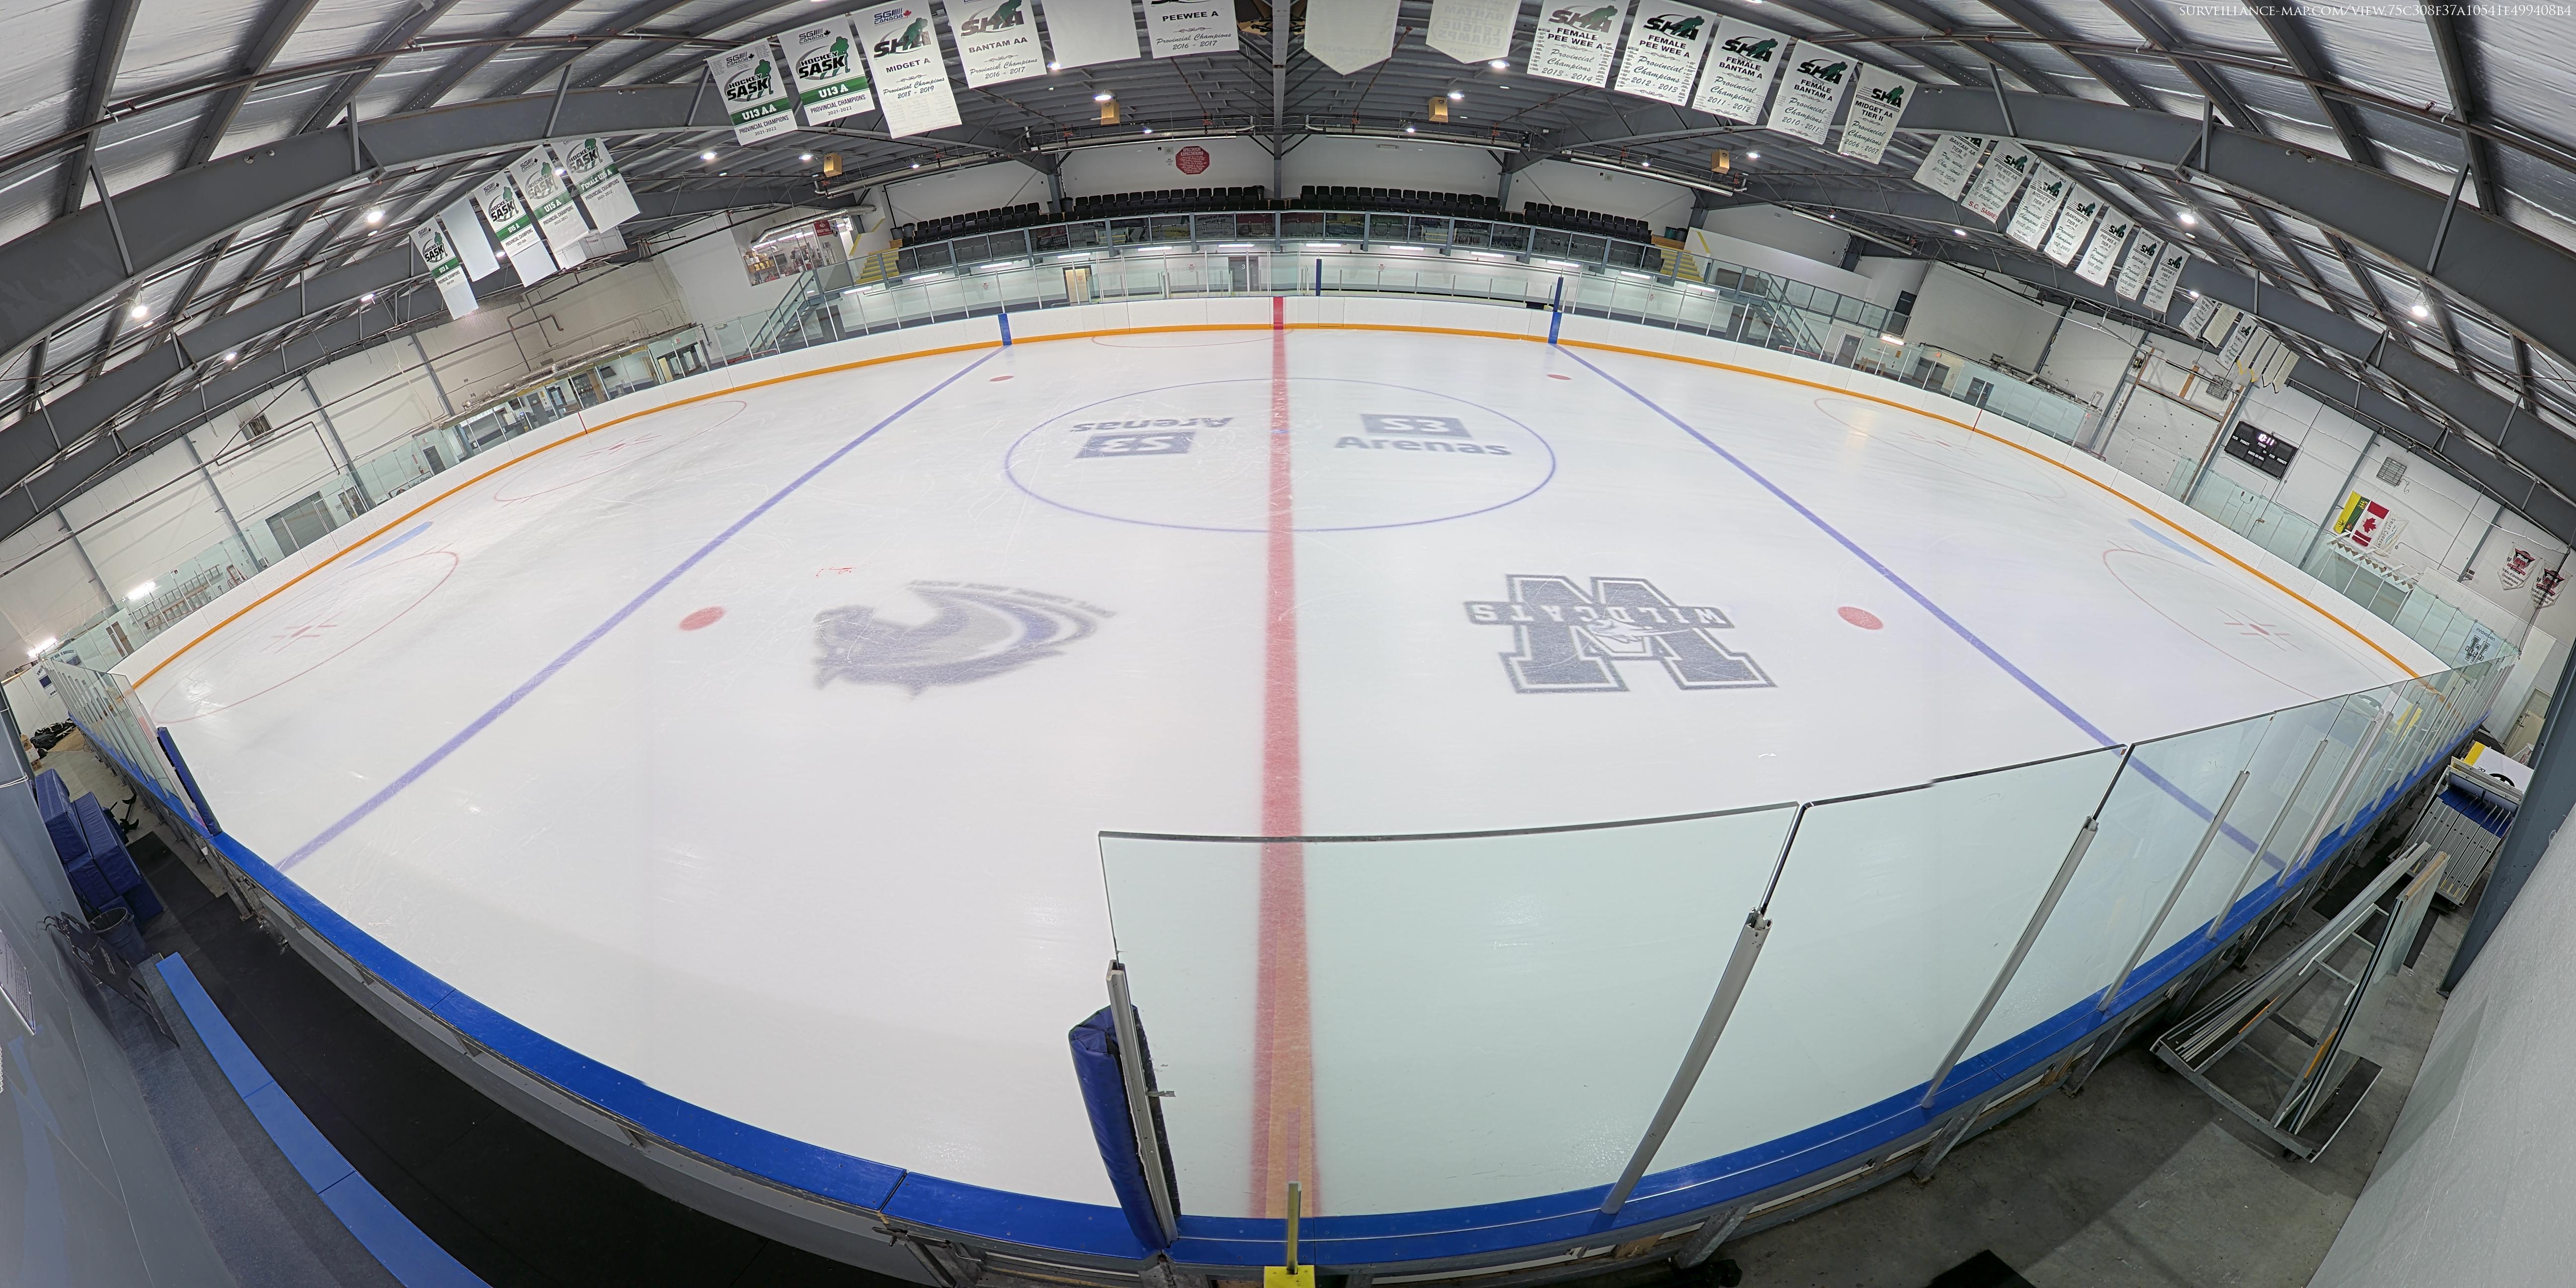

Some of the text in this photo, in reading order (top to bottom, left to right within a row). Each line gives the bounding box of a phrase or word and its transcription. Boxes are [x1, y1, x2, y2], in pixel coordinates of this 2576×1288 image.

[874, 14, 903, 25] CANADA
[961, 11, 1024, 37] SHA
[1162, 11, 1208, 22] PEEWEE
[1548, 10, 1612, 33] SHA
[1557, 28, 1598, 41] FEMALE
[1643, 18, 1699, 41] SHA
[799, 34, 824, 44] CANADA
[969, 40, 1010, 53] BANTAM
[1156, 35, 1191, 45] Provincial
[1548, 33, 1568, 42] PEE
[1572, 38, 1594, 48] WEE
[1648, 35, 1686, 49] FEMALE
[1639, 40, 1658, 49] PEE
[1661, 45, 1681, 56] WEE
[1721, 39, 1773, 62] SHA
[727, 57, 748, 67] CANADA
[801, 51, 838, 66] HOCKEY
[1551, 49, 1594, 63] Provincial
[1726, 56, 1761, 71] FEMALE
[798, 55, 846, 79] SASK
[886, 60, 920, 73] MIDGET
[970, 58, 1037, 75] Provincial Champions
[1010, 66, 1025, 74] 2017
[1547, 58, 1591, 71] Champions
[1638, 56, 1684, 73] Provincial
[1719, 62, 1755, 76] BANTAM
[1542, 67, 1592, 82] 2013 2014
[1634, 66, 1680, 83] Champions
[1797, 61, 1843, 85] SHA
[727, 77, 769, 101] SASK
[729, 74, 762, 89] HOCKEY
[882, 77, 945, 95] Provincial Champions
[1631, 77, 1678, 93] 2012 2013
[1714, 76, 1757, 94] Provincial
[1801, 79, 1832, 94] FEMALE
[819, 84, 848, 98] U13 A
[898, 86, 934, 99] 2018 2019
[1710, 86, 1752, 103] Champions
[1794, 84, 1826, 99] BANTAM
[1871, 88, 1902, 108] SHA
[742, 104, 777, 120] U13 AA
[811, 95, 866, 114] PROVINCIAL CHAMPIONS
[828, 106, 852, 115] 2021-2022
[1707, 97, 1726, 106] 2011
[1732, 103, 1751, 113] 2012
[1789, 98, 1826, 114] Provincial
[1855, 101, 1883, 114] MIDGET
[1785, 107, 1822, 123] Champions
[1862, 110, 1878, 119] TIER
[739, 115, 789, 134] PROVINCIAL CHAMPIONS
[755, 127, 777, 136] 2021-2022
[1782, 117, 1820, 132] 2010 2011
[1852, 121, 1886, 137] Provincial
[1848, 130, 1882, 146] Champions
[1949, 137, 1969, 151] BANTAM
[569, 145, 591, 162] HOCKEY
[1844, 139, 1879, 154] 2006 2007
[1952, 145, 1962, 155] TIER
[569, 148, 598, 173] SASK
[2004, 154, 2025, 174] SHA
[1997, 172, 2006, 181] TIER
[2003, 168, 2012, 177] WEE
[2048, 170, 2059, 179] MIDGET
[528, 174, 547, 189] HOCKEY
[528, 177, 553, 199] SASK
[581, 177, 599, 190] FEMALE
[1987, 179, 2009, 196] Provincial
[586, 179, 619, 201] PROVINCIAL CHAMPIONS
[597, 190, 612, 200] 2021-2022
[1982, 187, 2004, 202] Champions
[2032, 191, 2048, 202] MIDGET
[491, 198, 509, 212] HOCKEY
[491, 201, 515, 222] SASK
[544, 202, 556, 212] U15
[1968, 201, 1979, 210] S.C.
[543, 205, 574, 225] PROVINCIAL CHAMPIONS
[2019, 212, 2038, 226] Champions
[2023, 206, 2042, 220] Provincial
[2065, 211, 2081, 224] BANTAM
[505, 236, 520, 247] PROVINCIAL
[519, 228, 533, 239] CHAMPIONS
[424, 242, 439, 254] HOCKEY
[425, 245, 444, 262] SASK
[1071, 417, 1234, 432] Arenas
[1381, 418, 1450, 433] S3
[1334, 436, 1512, 456] Arenas
[2387, 518, 2395, 530] SWIFT
[2377, 531, 2388, 548] CURRENT
[2502, 573, 2518, 585] CHAMPIONS
[2512, 573, 2524, 583] DIVISION
[1473, 603, 1727, 624] WILDCATS
